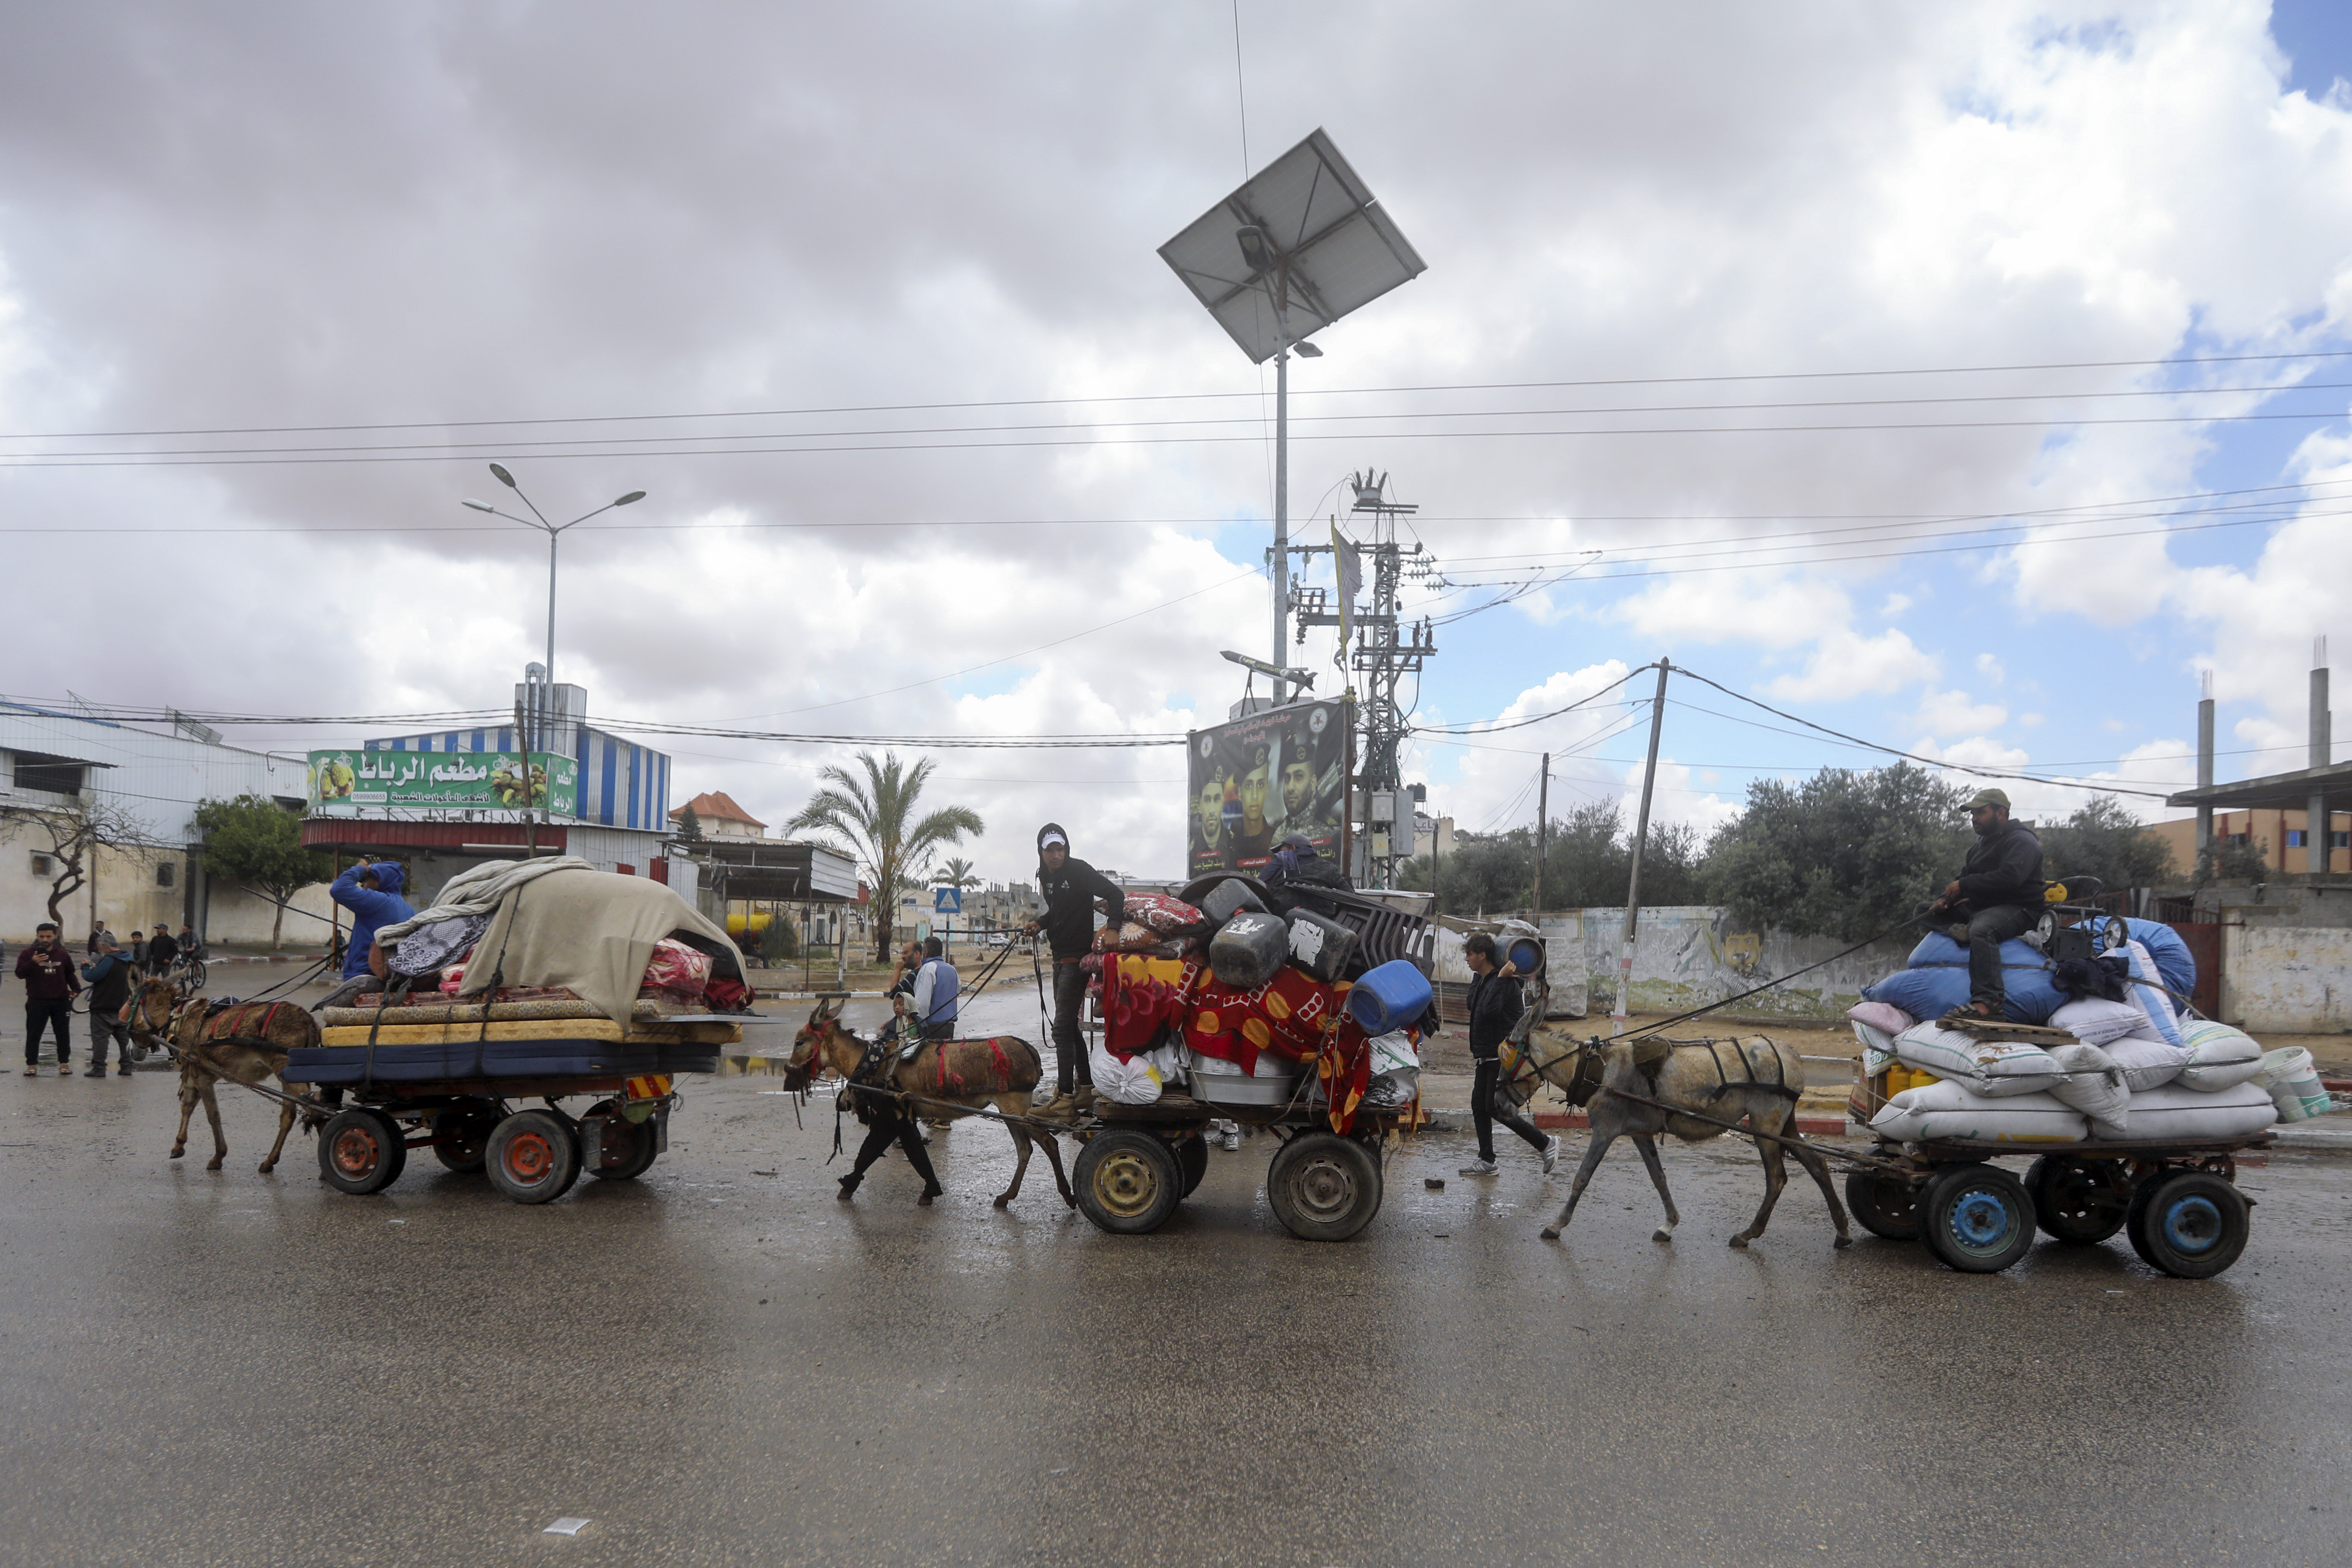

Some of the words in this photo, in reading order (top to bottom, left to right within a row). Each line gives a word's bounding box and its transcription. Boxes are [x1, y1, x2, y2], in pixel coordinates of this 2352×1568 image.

[358, 753, 425, 787] الرباط
[429, 756, 488, 788] مطعم
[556, 771, 572, 786] مطعم
[391, 791, 422, 803] الشعبية
[423, 790, 460, 803] المأكولات
[461, 792, 490, 802] لأشهى
[553, 791, 572, 813] الرباط
